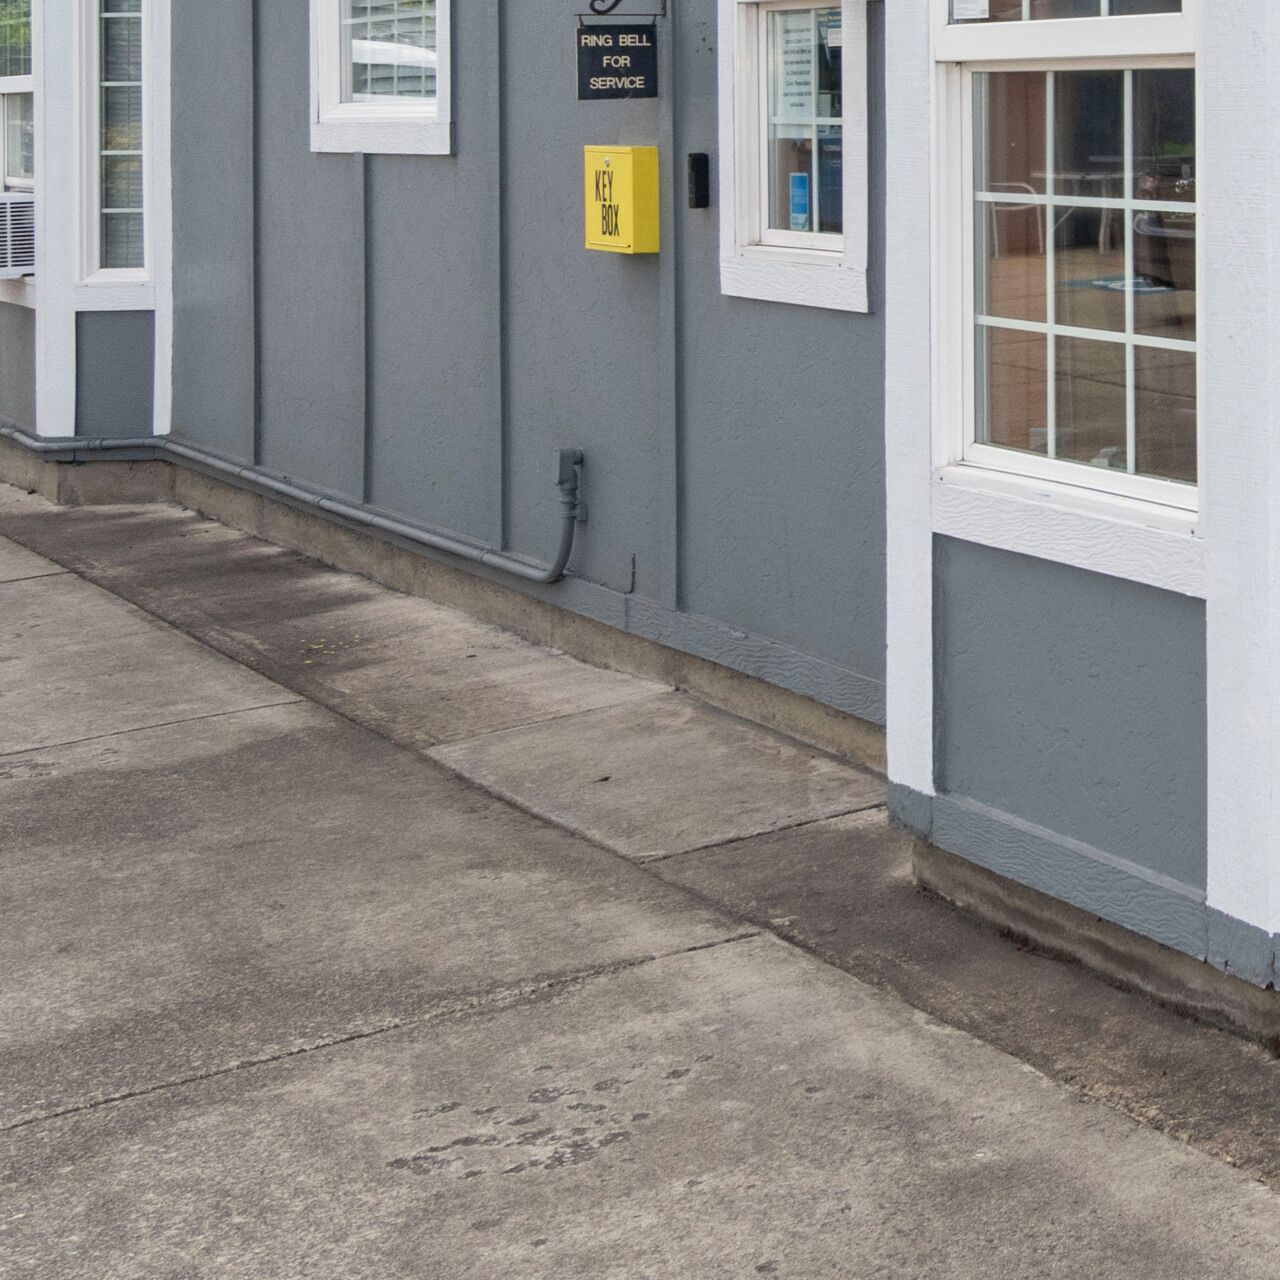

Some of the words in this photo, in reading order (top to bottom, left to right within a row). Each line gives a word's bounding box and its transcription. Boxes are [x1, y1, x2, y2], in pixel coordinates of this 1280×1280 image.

[581, 34, 613, 47] RING
[619, 34, 652, 46] BELL
[602, 55, 631, 68] FOR
[589, 76, 646, 89] SERVICE
[595, 170, 614, 203] KEY
[601, 203, 620, 237] BOX
